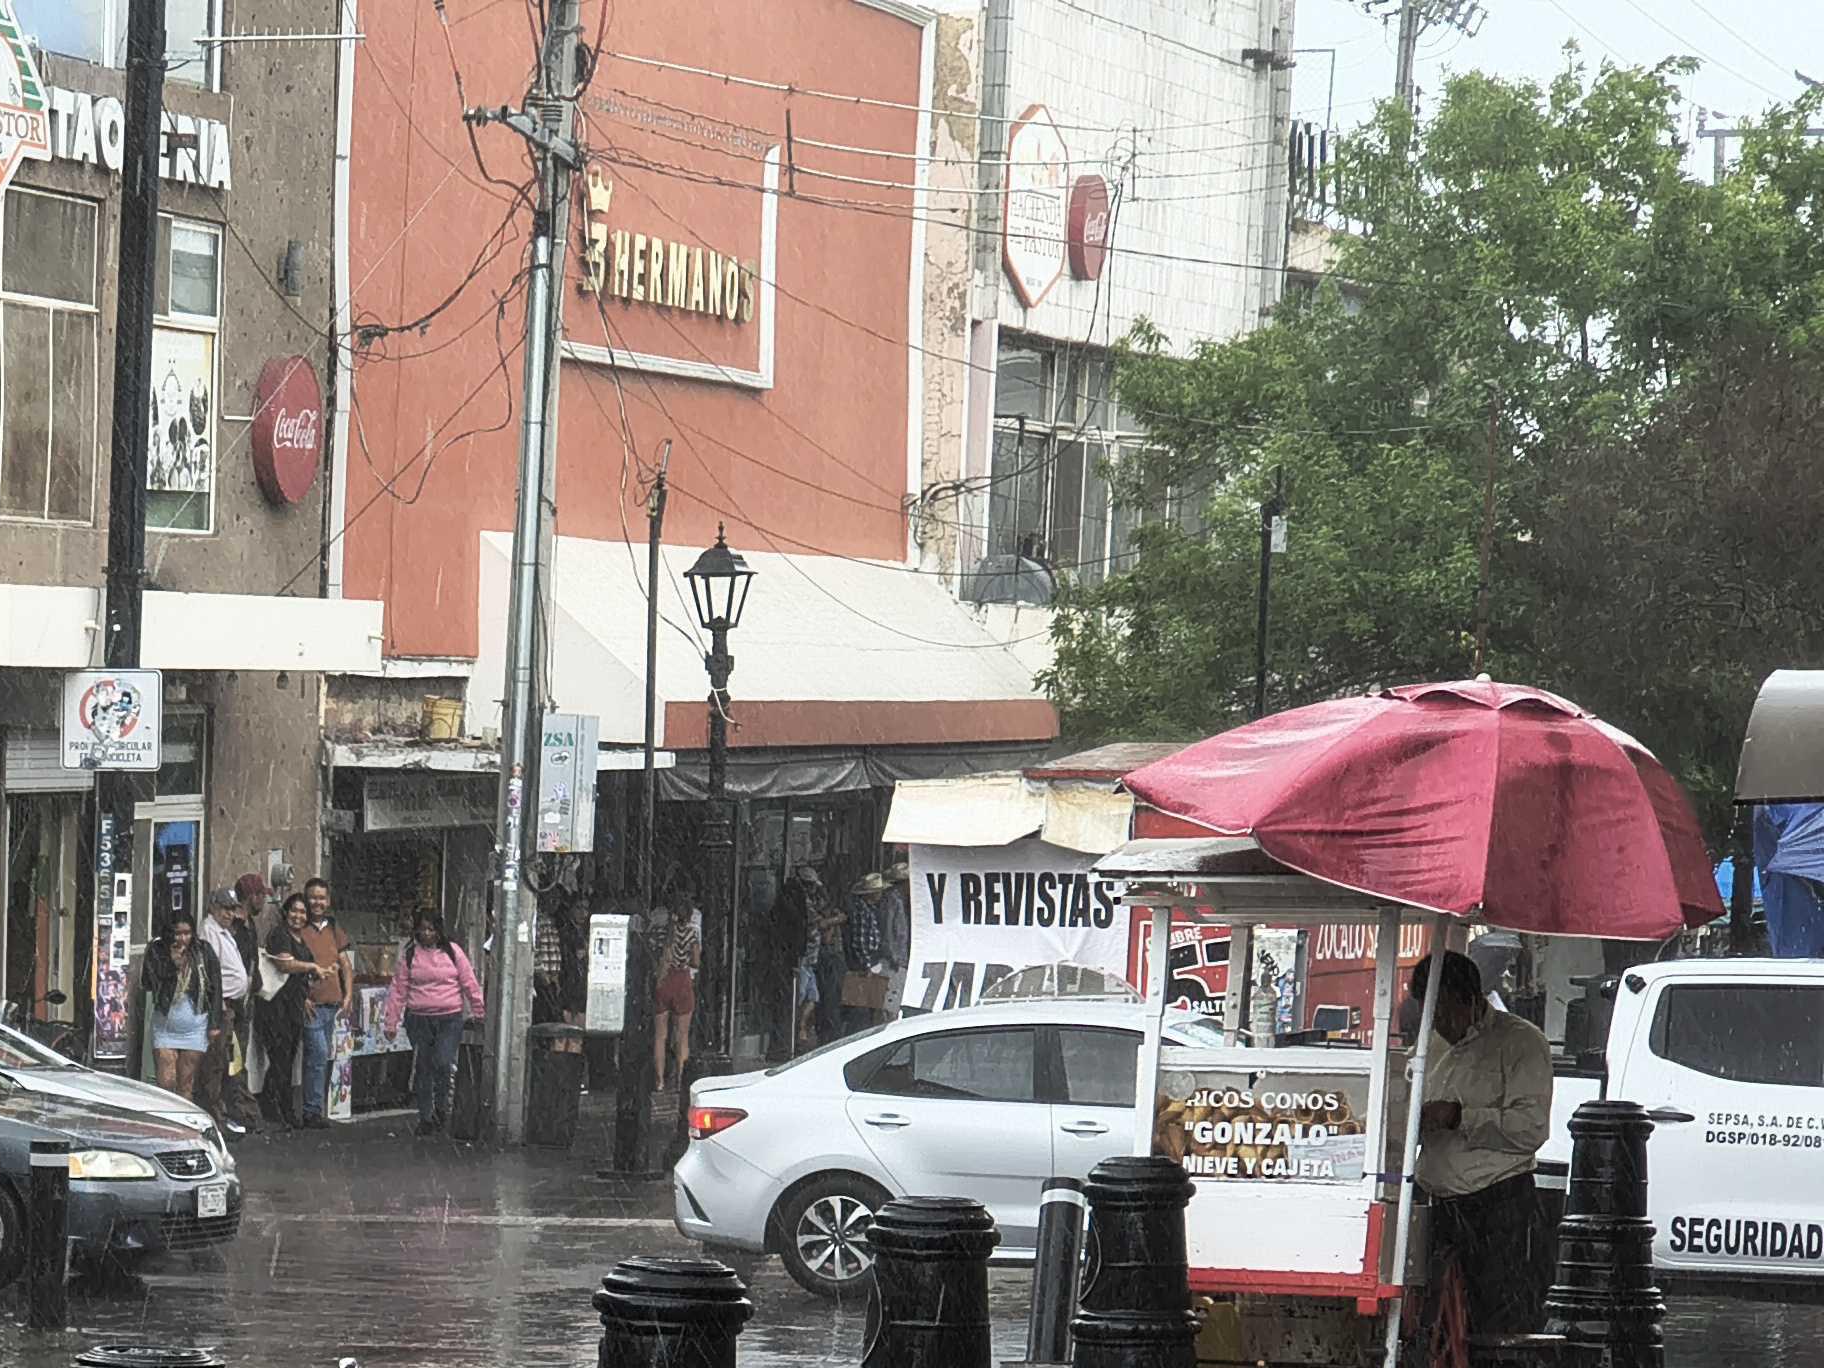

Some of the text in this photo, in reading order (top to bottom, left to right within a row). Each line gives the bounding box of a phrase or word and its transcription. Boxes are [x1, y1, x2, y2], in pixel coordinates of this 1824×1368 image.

[50, 85, 232, 190] TAQERIA
[614, 230, 758, 323] HERMANOS
[926, 871, 1115, 929] Y REVISTAS
[1185, 1090, 1339, 1111] RICOS CONOS
[1707, 1112, 1754, 1129] SEPSA,
[1757, 1115, 1783, 1129] S.A.
[1786, 1116, 1804, 1129] DE
[1184, 1121, 1339, 1146] "GONZALO"
[1705, 1130, 1824, 1149] DGSP/018-92/08
[1182, 1154, 1238, 1175] NIEVE
[1245, 1157, 1257, 1175] Y
[1261, 1158, 1335, 1178] CAJETA
[1669, 1216, 1824, 1260] SEGURIDAD
